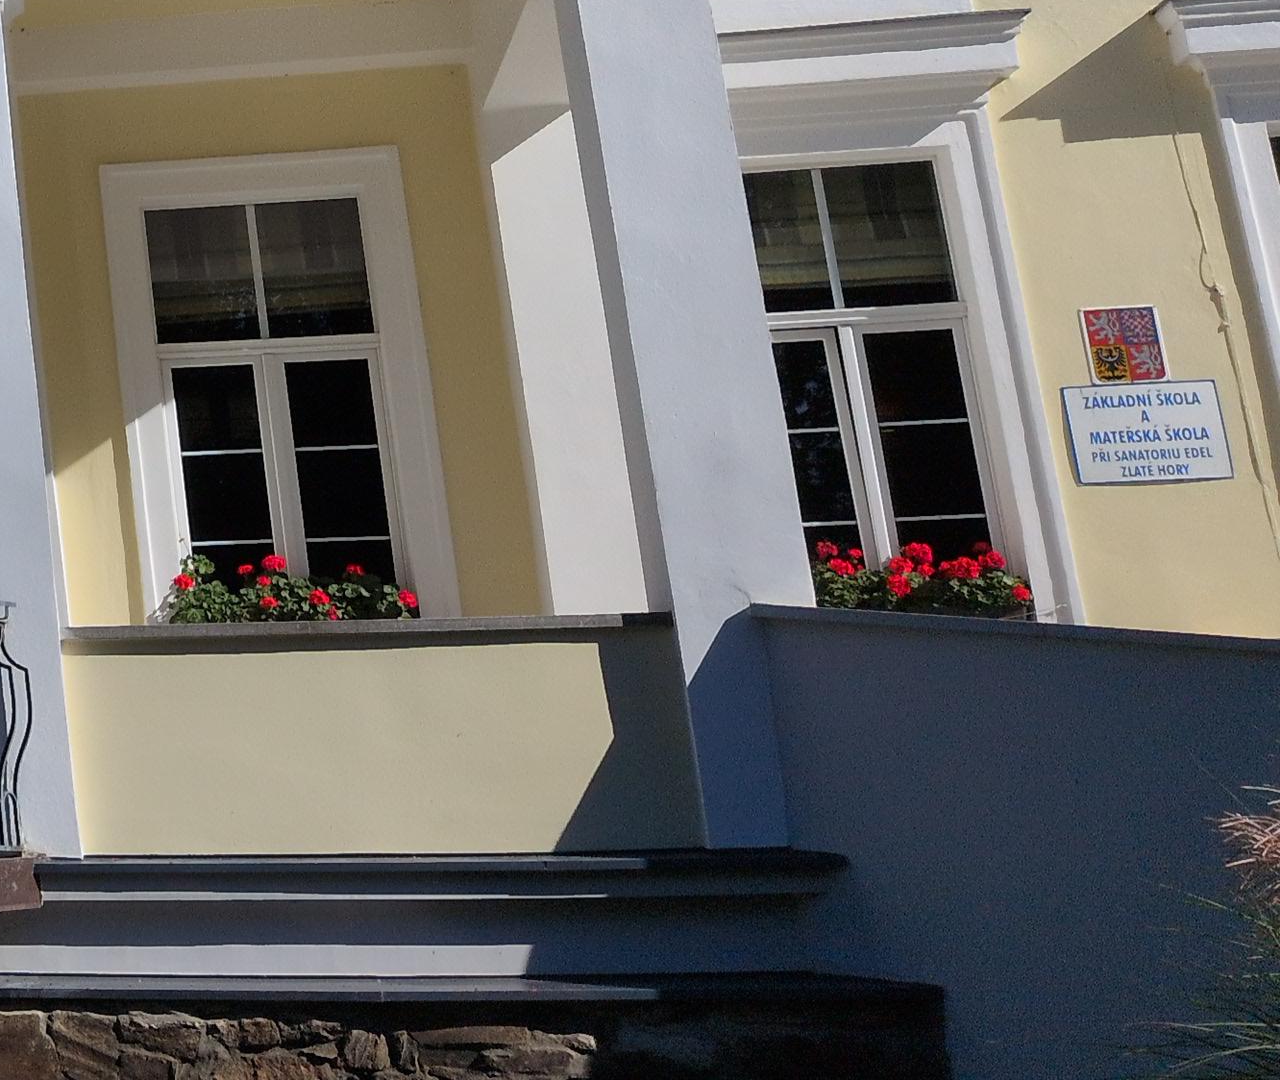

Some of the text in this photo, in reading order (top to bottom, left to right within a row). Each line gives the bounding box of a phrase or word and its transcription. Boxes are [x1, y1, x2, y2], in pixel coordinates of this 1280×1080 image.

[1082, 389, 1201, 409] ZÁKLADNÍ ŠKOLA
[1141, 410, 1150, 423] A
[1090, 424, 1210, 445] MATEŘSKÁ ŠKOLA
[1092, 446, 1213, 463] PŘI SANATORIU EDEL
[1121, 461, 1189, 478] ZLATÉ HORY
